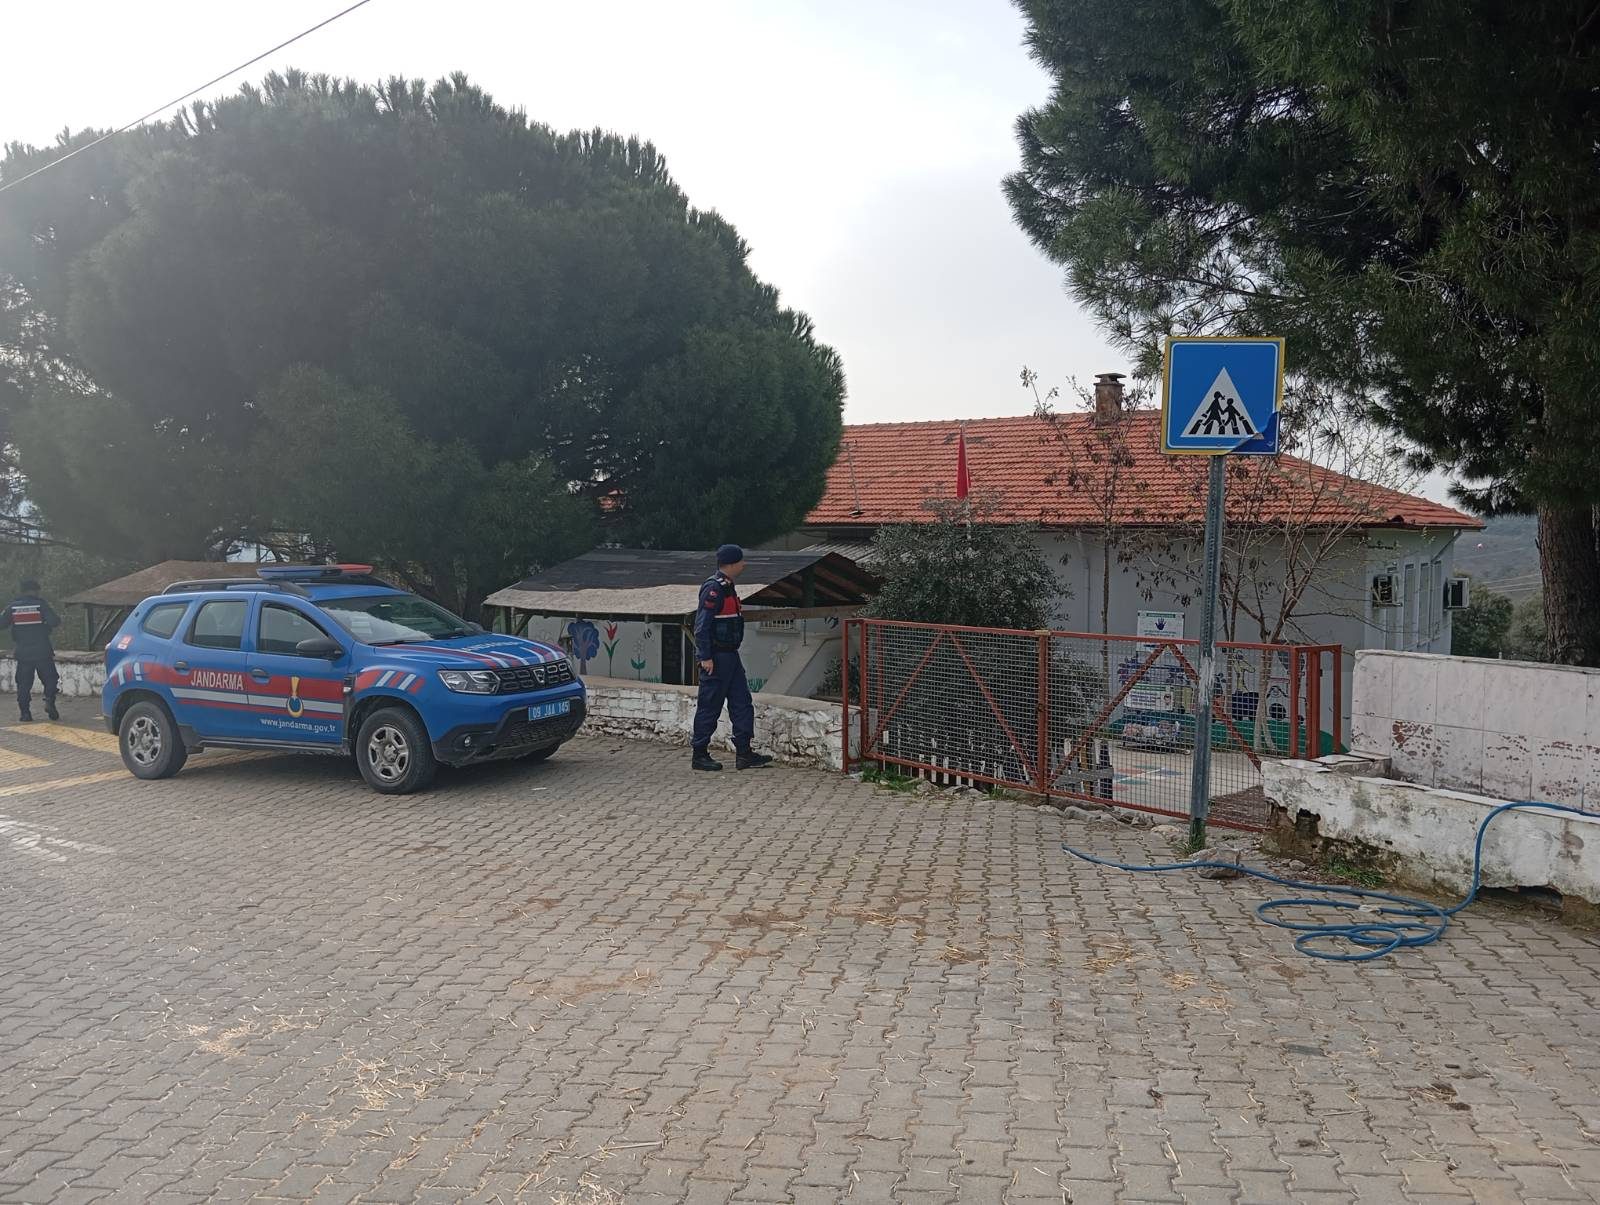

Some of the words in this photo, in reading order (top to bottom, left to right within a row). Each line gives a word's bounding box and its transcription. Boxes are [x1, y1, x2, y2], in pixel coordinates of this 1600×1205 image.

[190, 670, 244, 691] JANDARMA
[532, 706, 541, 719] 09
[260, 717, 336, 734] www.jandarma.gov.tr
